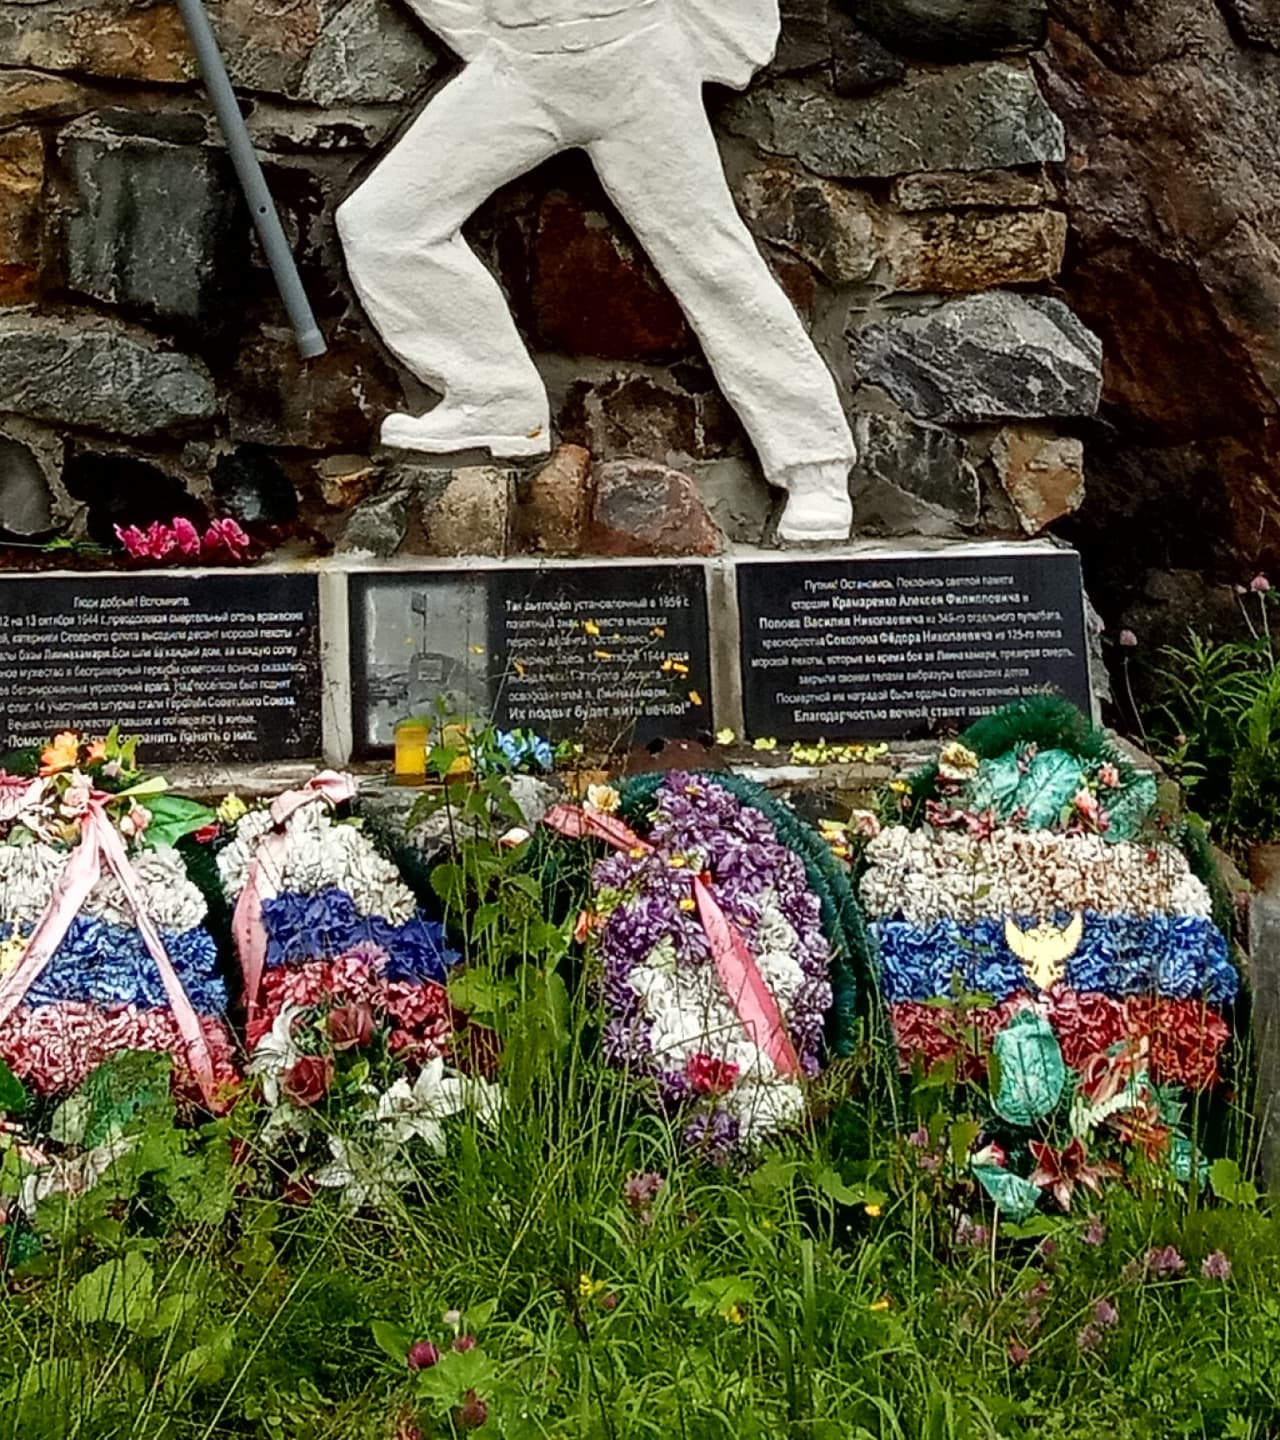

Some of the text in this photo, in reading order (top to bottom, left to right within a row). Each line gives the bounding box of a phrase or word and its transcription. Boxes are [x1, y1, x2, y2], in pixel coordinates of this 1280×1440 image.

[945, 576, 980, 587] светлой
[982, 575, 1014, 586] памяти
[100, 596, 138, 609] добрые!
[574, 598, 648, 612] установленный
[832, 595, 897, 611] Крамаренко
[898, 593, 944, 607] Алексея
[945, 593, 1021, 605] Филипповича
[1022, 594, 1029, 603] и
[0, 615, 9, 627] 12
[11, 618, 23, 627] на
[25, 615, 36, 627] 13
[38, 615, 75, 627] октября
[77, 613, 98, 626] 1944
[168, 612, 229, 626] смертельный
[230, 612, 256, 623] огонь
[257, 612, 304, 624] вражеских
[759, 616, 801, 629] Попова
[804, 615, 851, 628] Василия
[853, 613, 924, 627] Николаевича
[967, 612, 1015, 623] отдельного
[12, 633, 58, 644] катерники
[60, 631, 108, 643] Северного
[110, 632, 139, 644] флота
[141, 631, 187, 642] высадили
[187, 630, 219, 642] десант
[221, 629, 258, 640] морской
[260, 629, 292, 639] пехоты
[826, 632, 878, 646] Соколова
[922, 629, 992, 643] Николаевича
[995, 631, 1005, 640] из
[1008, 628, 1035, 640] 125-го
[1036, 629, 1062, 639] полка
[18, 649, 42, 661] базы
[132, 648, 152, 658] шли
[165, 647, 200, 659] каждый
[224, 647, 235, 656] за
[236, 646, 271, 657] каждую
[752, 655, 788, 669] морской
[791, 655, 825, 666] пехоты,
[827, 654, 863, 667] которые
[865, 654, 876, 664] во
[877, 652, 905, 664] время
[925, 651, 935, 662] за
[1000, 648, 1040, 660] презирая
[19, 667, 64, 680] мужество
[66, 667, 72, 677] и
[74, 665, 141, 678] беспримерный
[182, 663, 226, 674] советских
[227, 663, 259, 674] воинов
[799, 674, 836, 685] закрыли
[838, 673, 870, 683] своими
[872, 671, 904, 682] телами
[956, 668, 1002, 680] вражеских
[11, 684, 88, 697] бетонированных
[90, 681, 142, 695] укреплений
[239, 678, 258, 690] был
[260, 678, 291, 689] поднят
[776, 692, 830, 705] Посмертной
[832, 691, 845, 702] им
[847, 689, 888, 705] наградой
[889, 688, 913, 701] были
[915, 688, 947, 701] ордена
[949, 685, 1019, 698] Отечественной
[34, 702, 46, 712] 14
[47, 701, 98, 714] участников
[100, 700, 136, 712] штурма
[137, 699, 163, 710] стали
[208, 696, 261, 707] Советского
[509, 707, 526, 720] Их
[574, 705, 609, 720] будет
[154, 716, 160, 726] и
[794, 708, 887, 723] Благодарностью
[889, 705, 928, 720] вечной
[930, 705, 965, 717] станет
[223, 731, 231, 741] о
